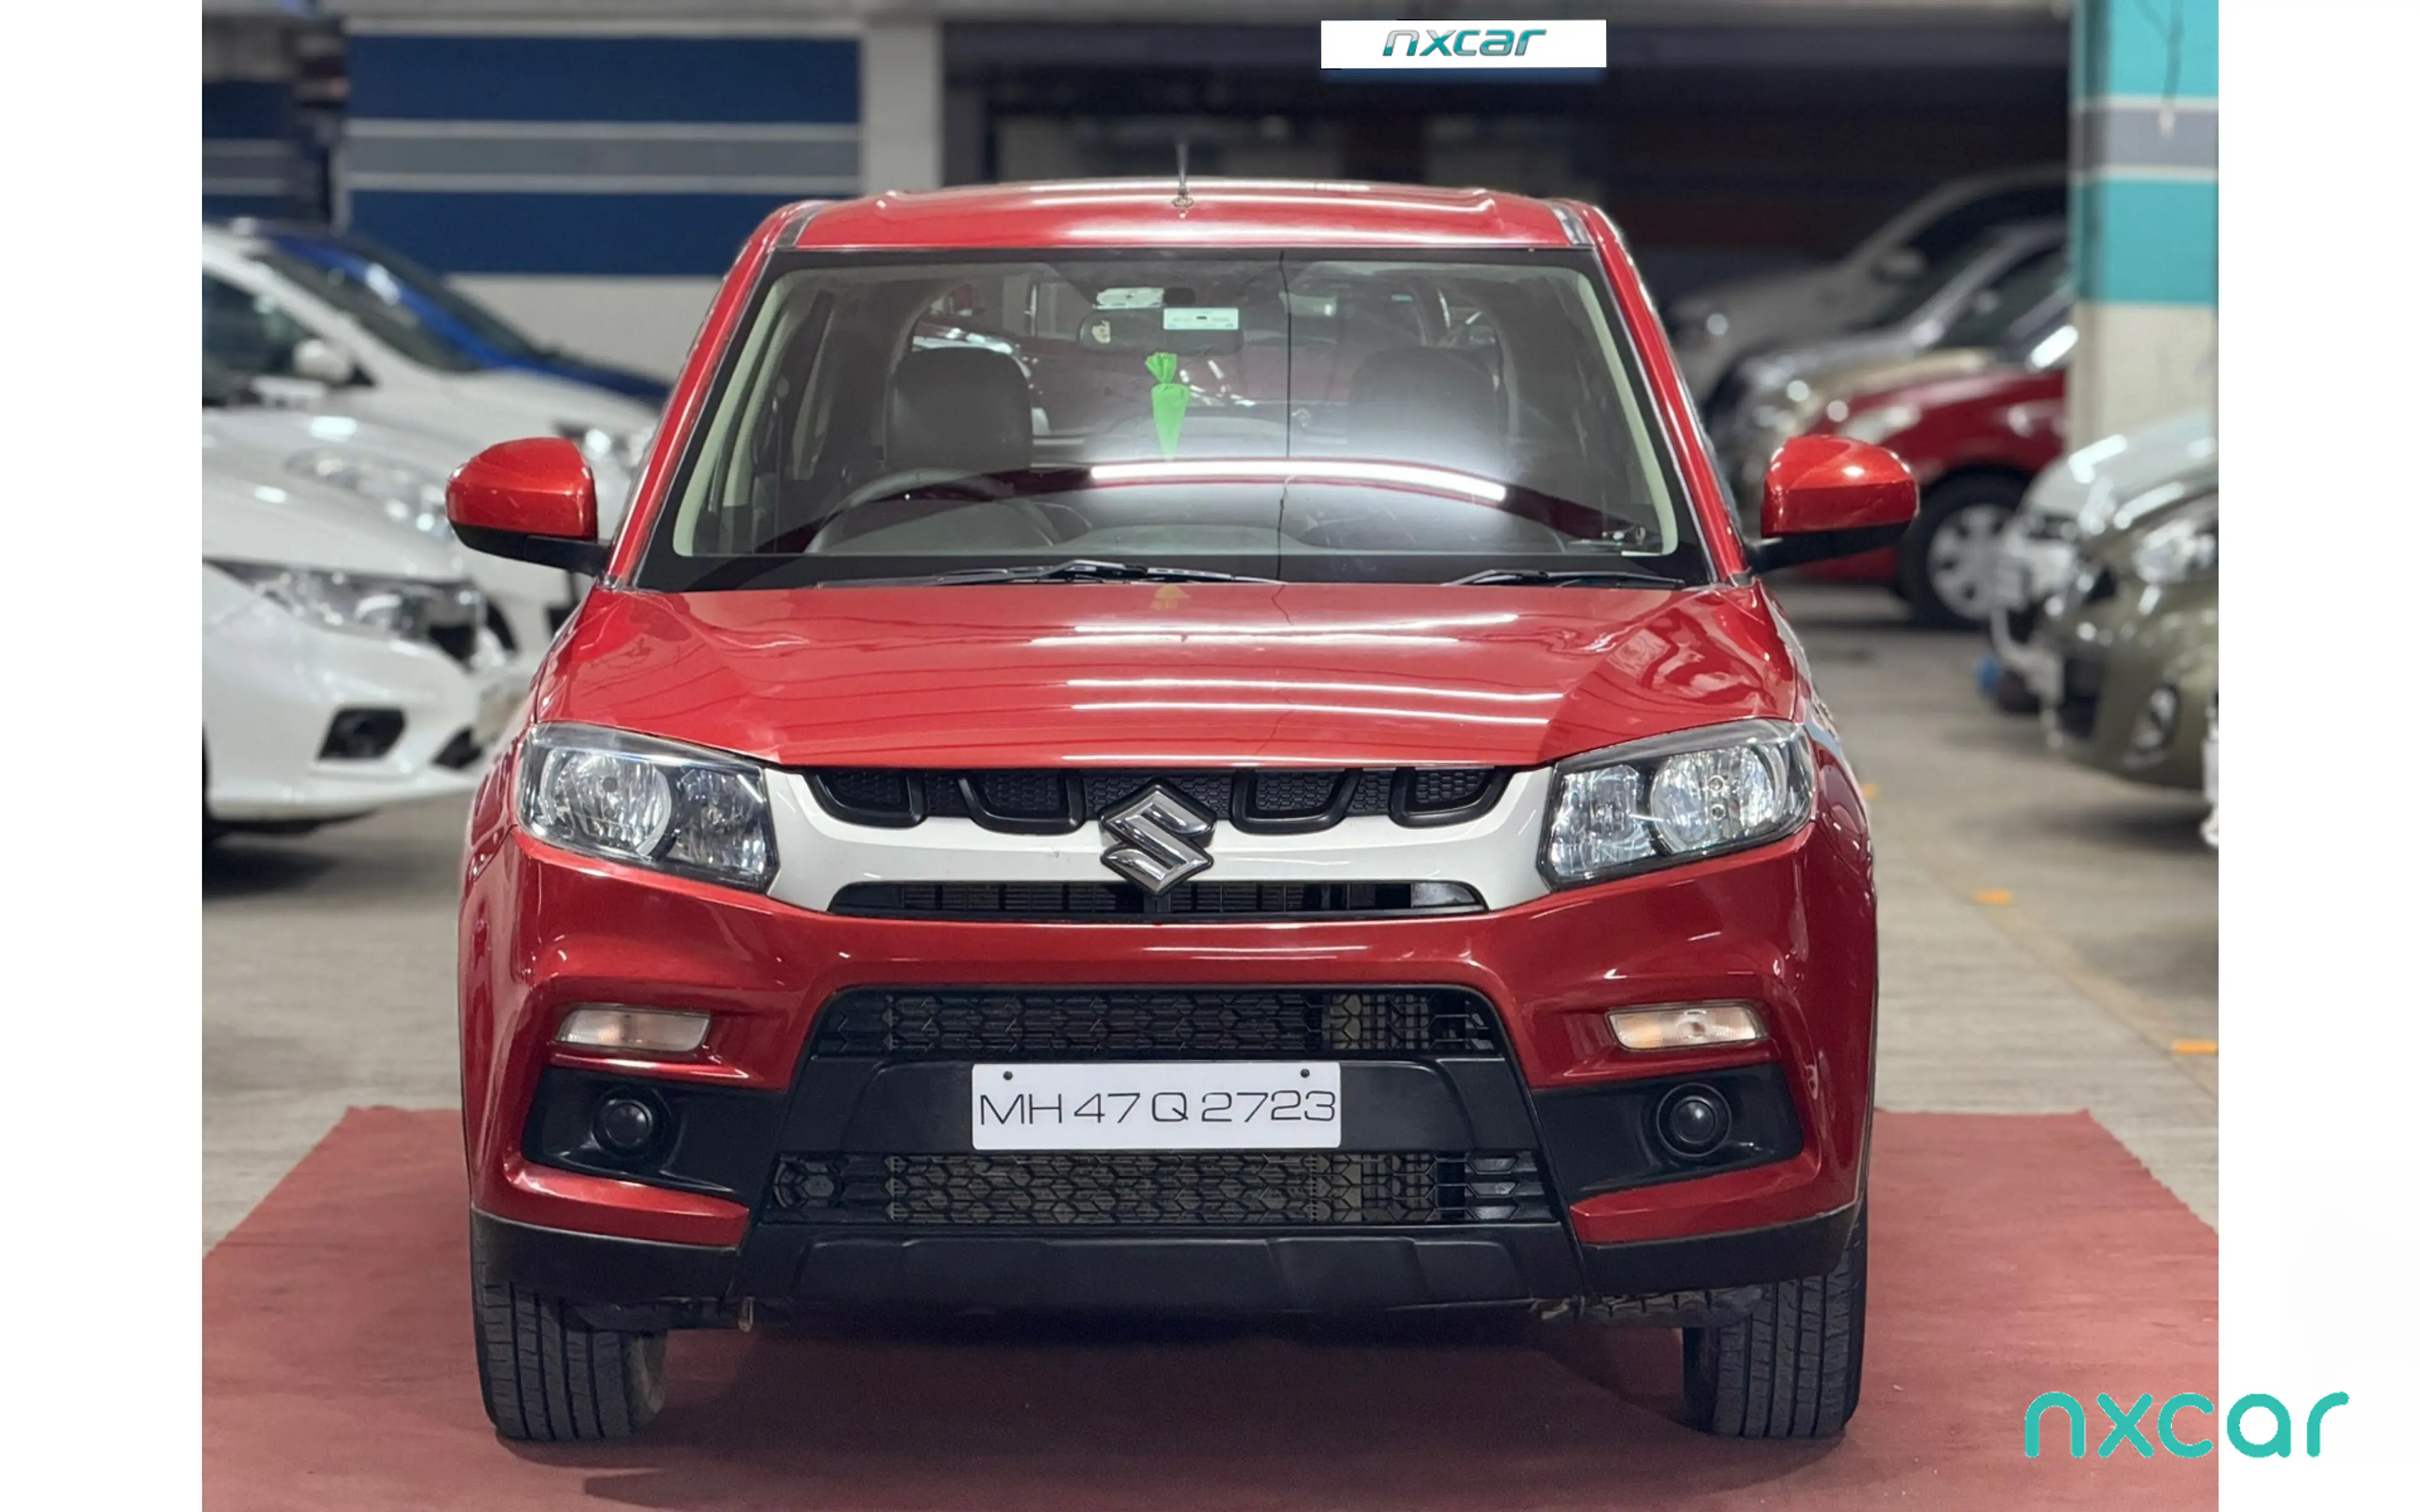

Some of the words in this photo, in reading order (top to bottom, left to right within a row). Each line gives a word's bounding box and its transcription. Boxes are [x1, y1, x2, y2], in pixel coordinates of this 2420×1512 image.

[980, 1093, 1063, 1125] MH
[1073, 1092, 1141, 1124] 47
[1151, 1092, 1189, 1123] Q
[1201, 1090, 1336, 1123] 2723
